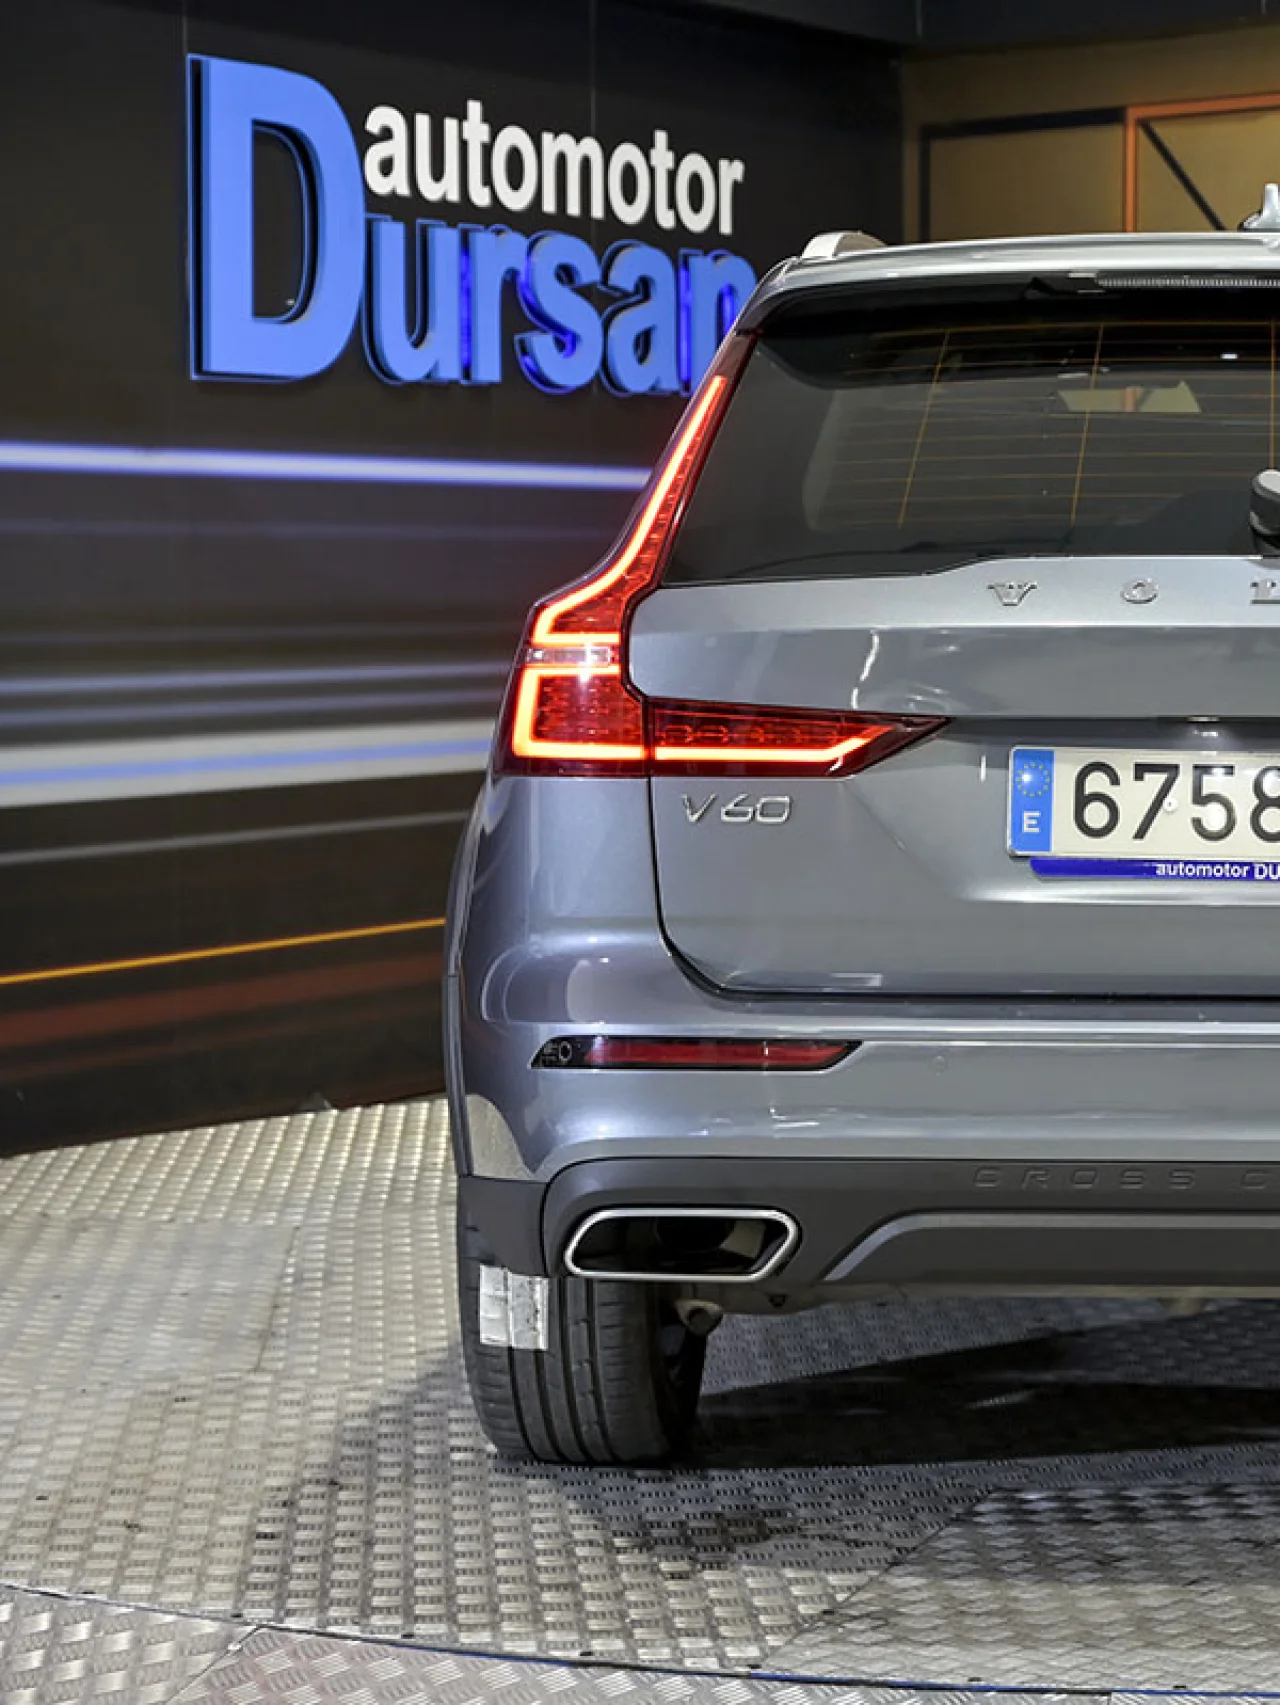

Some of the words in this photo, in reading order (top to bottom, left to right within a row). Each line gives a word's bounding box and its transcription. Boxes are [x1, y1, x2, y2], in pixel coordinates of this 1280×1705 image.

[364, 99, 744, 235] automotor
[187, 53, 757, 396] Dursan
[682, 794, 792, 823] V60
[1023, 813, 1041, 833] E
[1156, 860, 1248, 878] automotor
[973, 1167, 1197, 1190] CROSS
